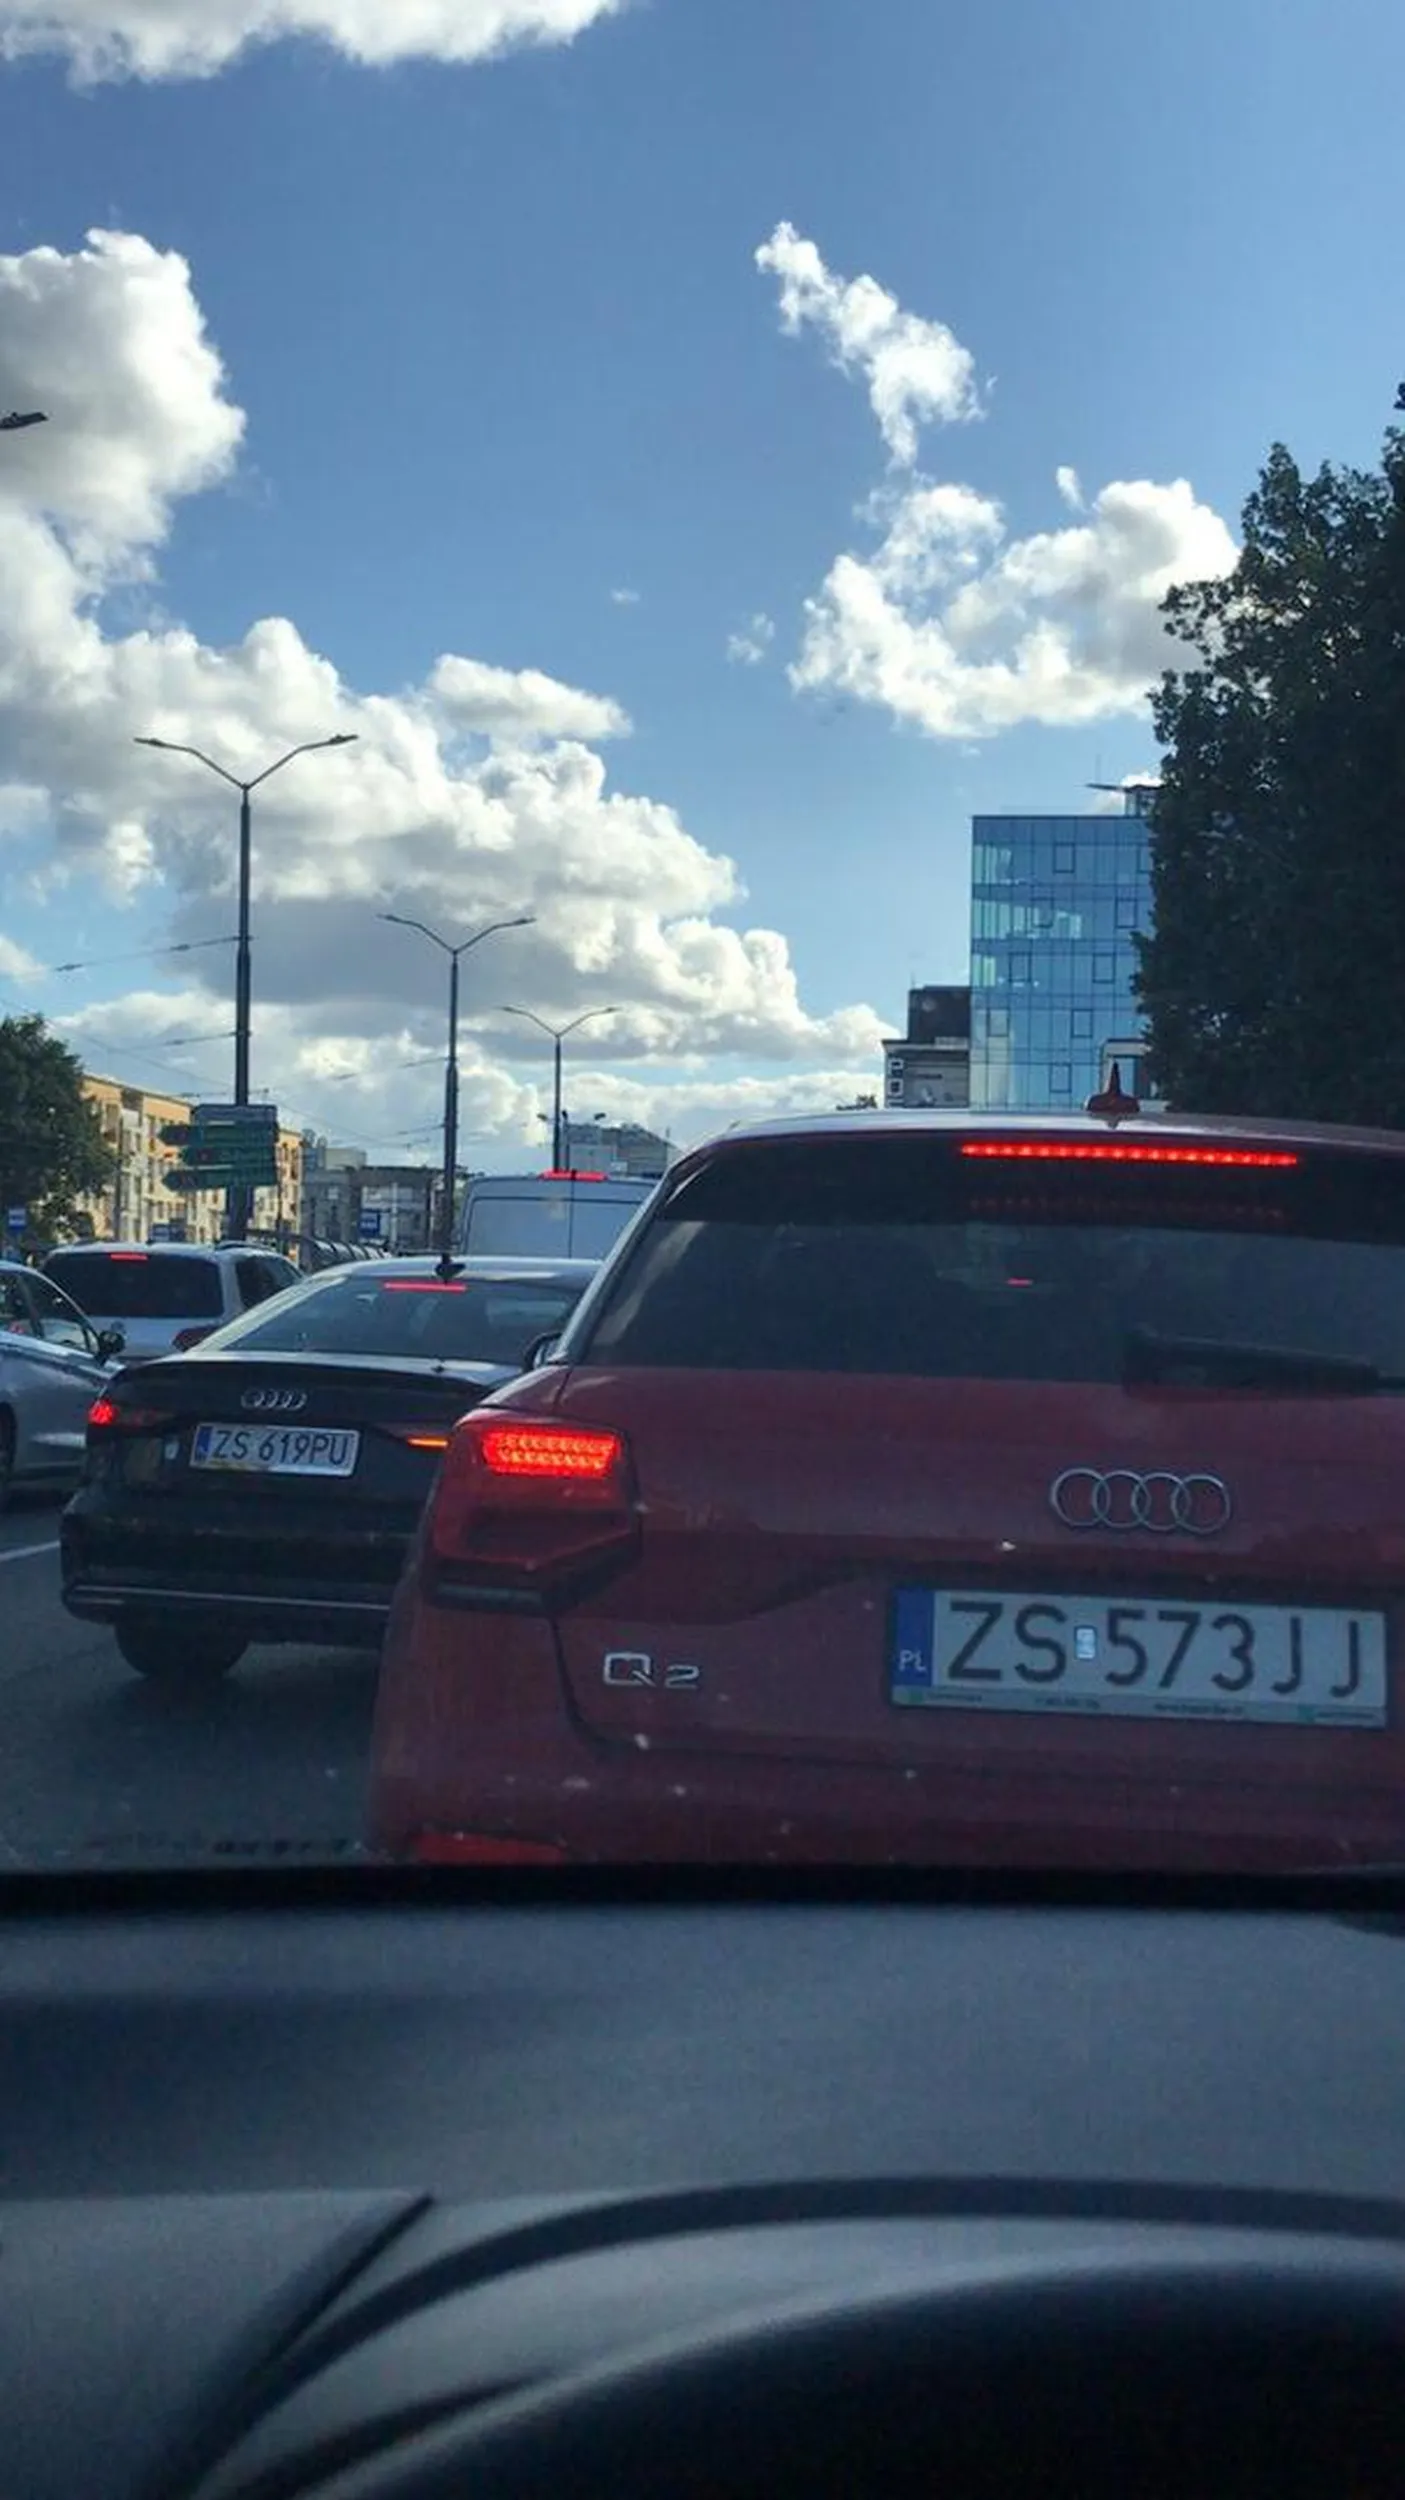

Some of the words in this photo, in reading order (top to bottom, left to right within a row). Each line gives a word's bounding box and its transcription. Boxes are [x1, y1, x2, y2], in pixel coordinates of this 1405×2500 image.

[211, 1430, 250, 1460] ZS
[258, 1430, 349, 1466] 619PU
[899, 1648, 927, 1671] PL
[947, 1601, 1068, 1684] ZS
[1104, 1608, 1361, 1699] 573JJ
[603, 1652, 700, 1689] Q2
